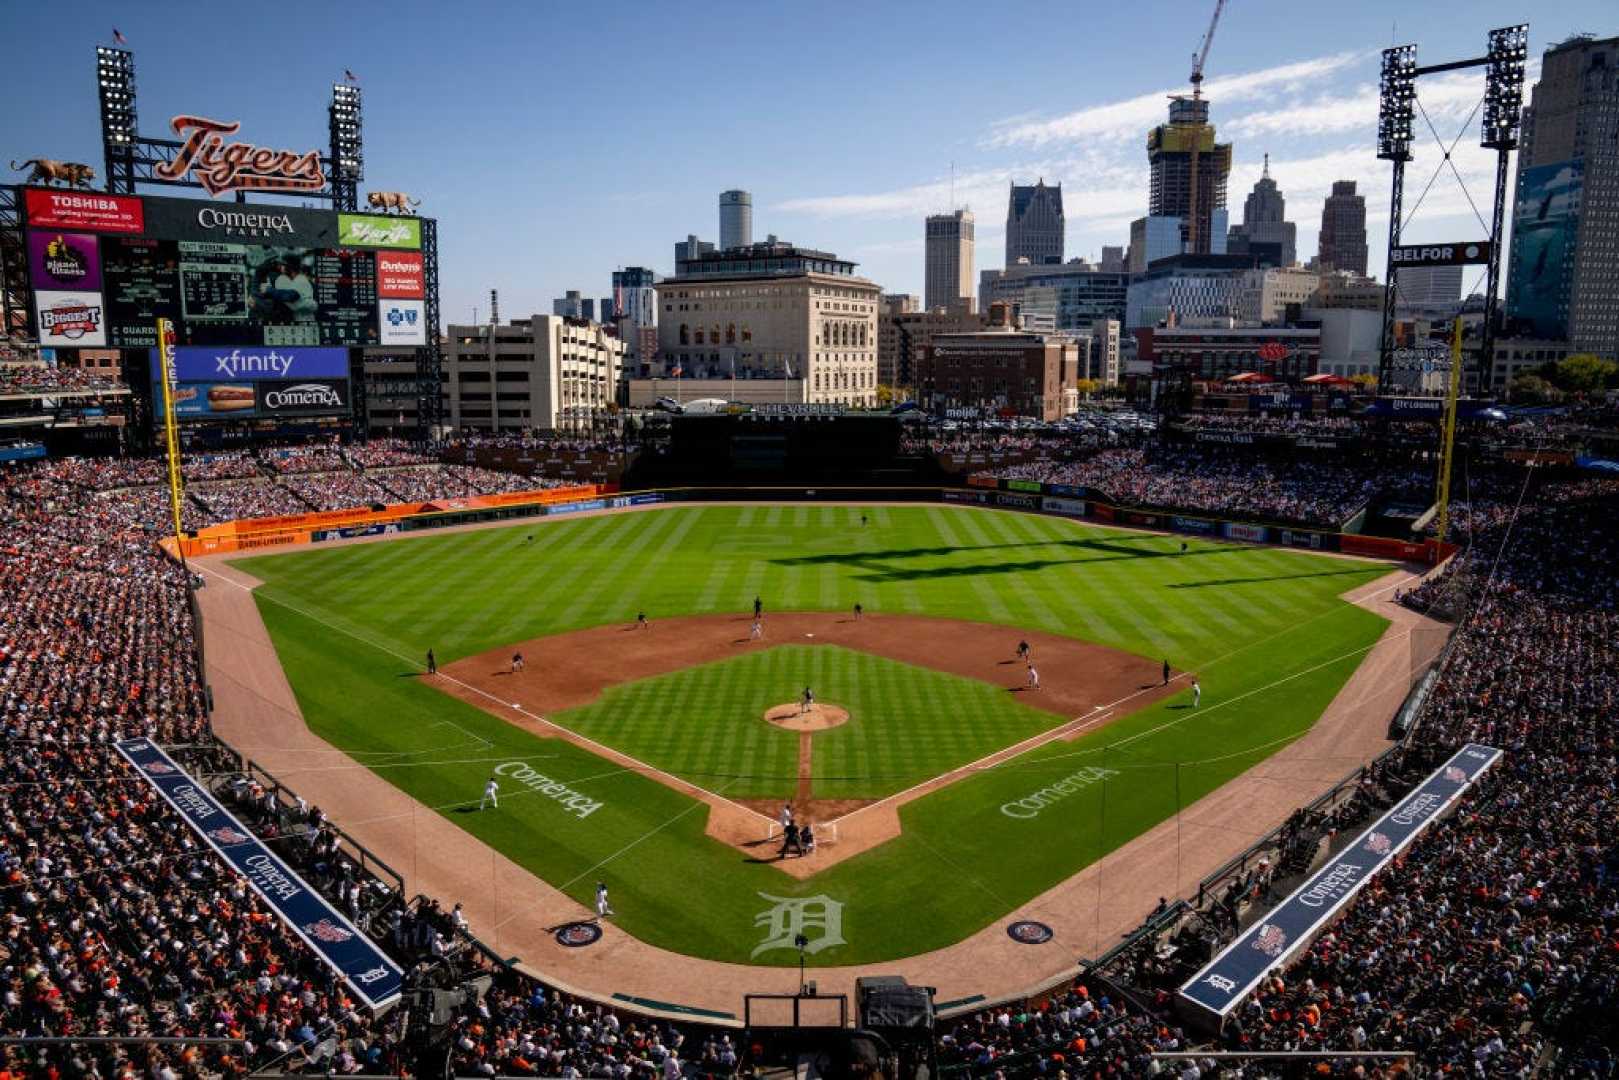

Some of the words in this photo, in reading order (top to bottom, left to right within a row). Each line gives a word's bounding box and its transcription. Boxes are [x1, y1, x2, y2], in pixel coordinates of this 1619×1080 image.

[155, 115, 326, 197] Tigers
[51, 195, 118, 210] TOSHIBA
[226, 227, 270, 238] PARK
[1391, 247, 1453, 262] BELFOR
[43, 307, 98, 328] BIGGEST
[215, 350, 294, 377] xfinity
[945, 408, 980, 420] meijer
